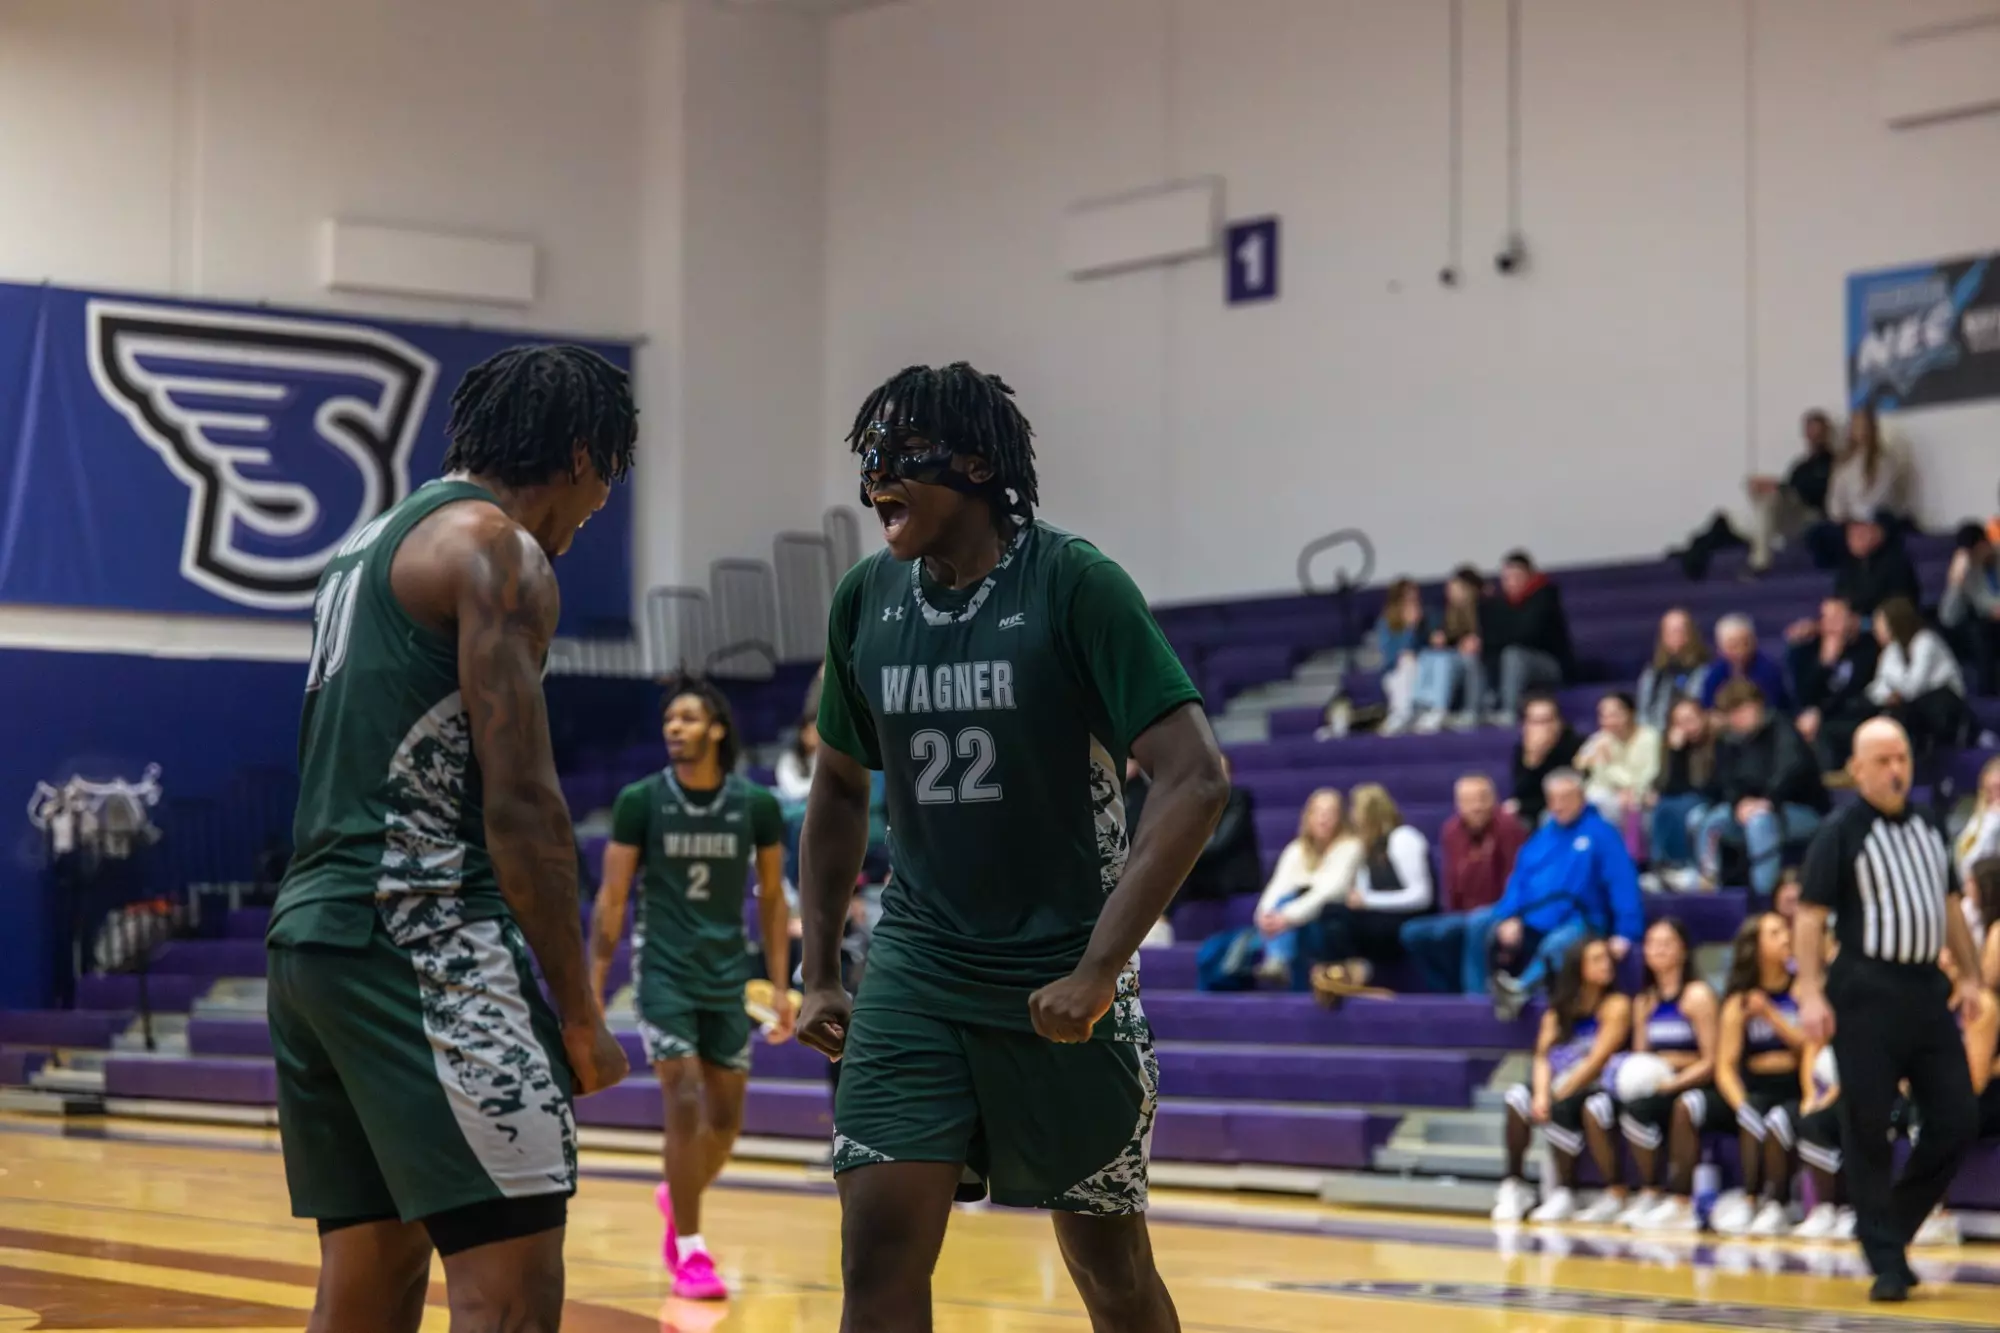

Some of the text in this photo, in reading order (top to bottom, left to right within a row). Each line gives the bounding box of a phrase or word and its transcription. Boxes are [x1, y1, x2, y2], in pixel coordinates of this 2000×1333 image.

[1235, 231, 1266, 290] 1
[881, 660, 1017, 714] WAGNER
[910, 726, 1003, 804] 22
[686, 862, 710, 899] 2
